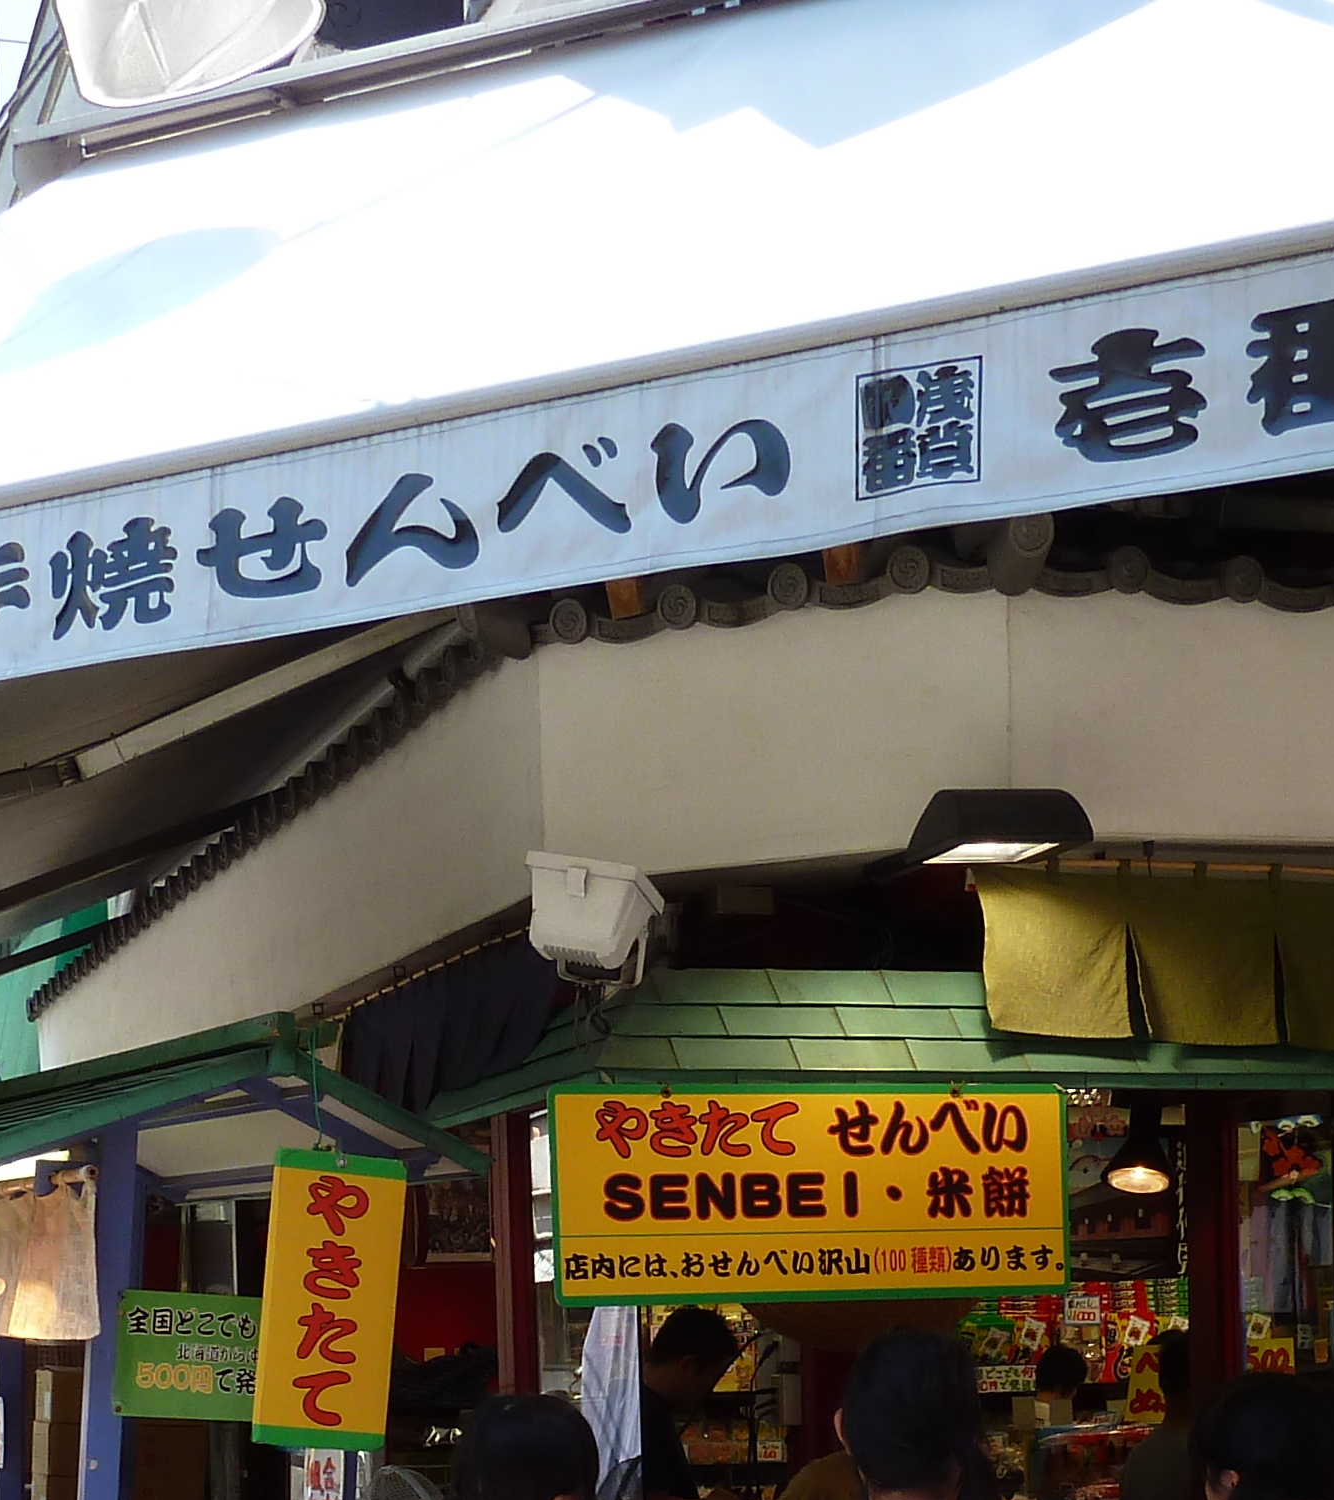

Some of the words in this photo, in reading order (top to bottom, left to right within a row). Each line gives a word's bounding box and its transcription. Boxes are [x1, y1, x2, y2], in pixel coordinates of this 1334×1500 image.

[595, 1100, 800, 1158] やきたて
[827, 1098, 1029, 1157] せんべい
[127, 1306, 258, 1340] 全国どこでも
[291, 1174, 370, 1427] やきたて
